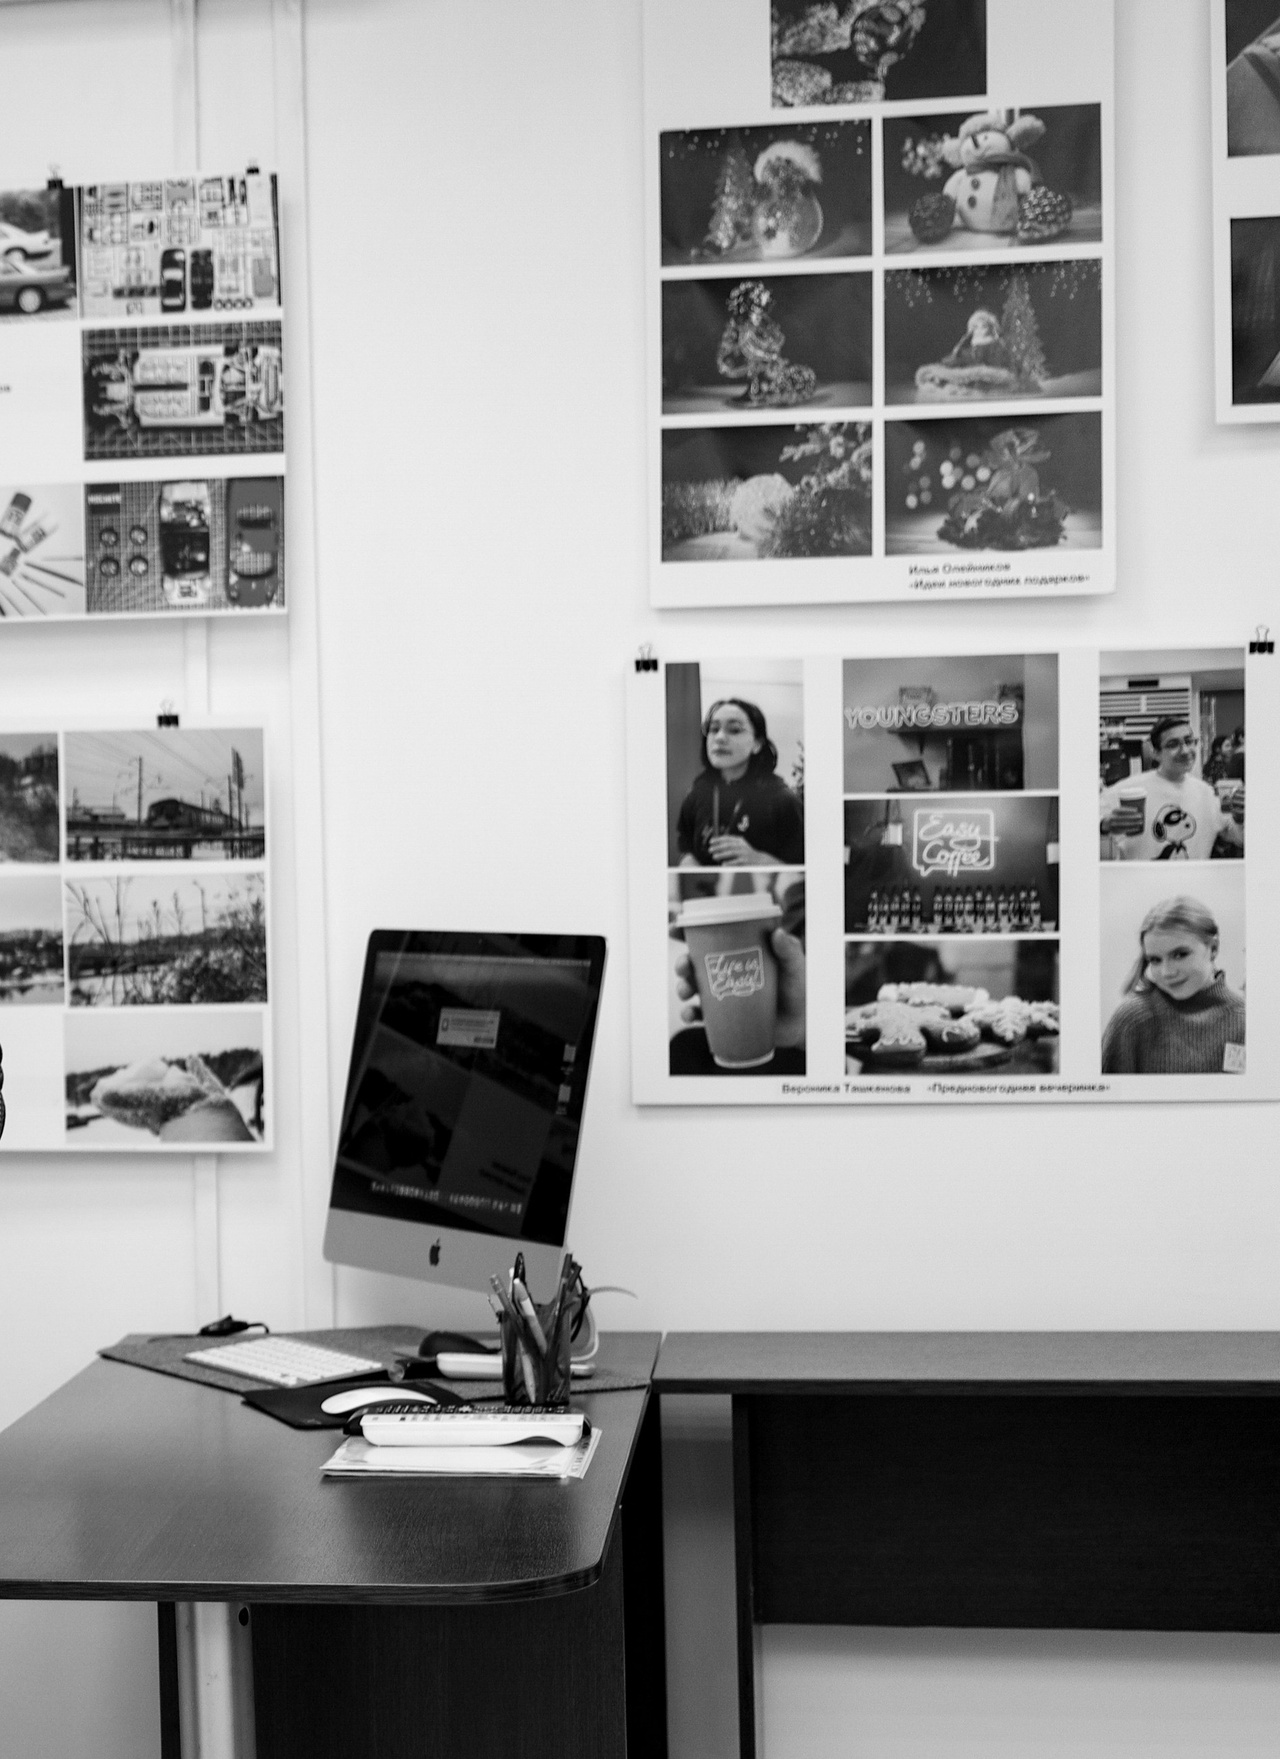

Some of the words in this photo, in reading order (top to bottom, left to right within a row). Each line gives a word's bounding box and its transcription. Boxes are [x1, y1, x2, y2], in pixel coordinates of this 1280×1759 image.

[909, 565, 939, 575] Илья
[942, 563, 1011, 574] Олейников
[844, 702, 1018, 729] YOUNGSTERS
[919, 814, 994, 850] Easy
[922, 838, 990, 877] Coffee
[782, 1084, 840, 1095] Вероника
